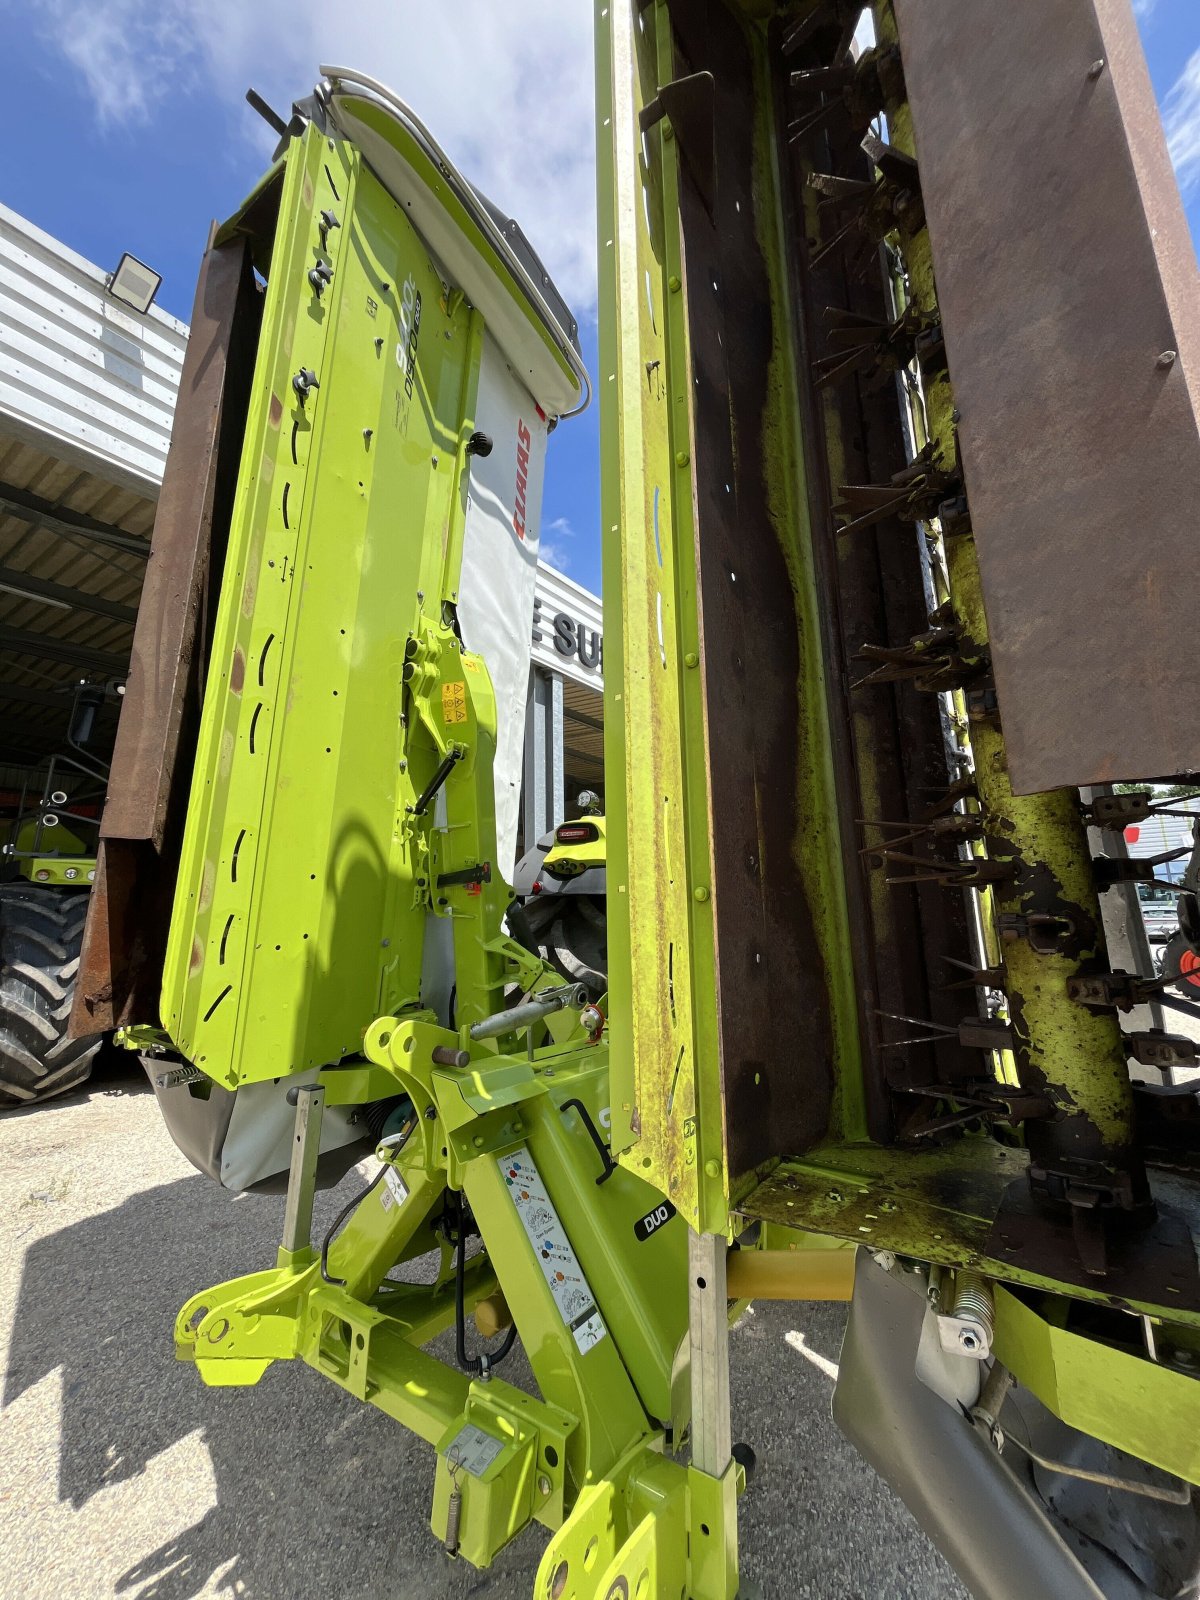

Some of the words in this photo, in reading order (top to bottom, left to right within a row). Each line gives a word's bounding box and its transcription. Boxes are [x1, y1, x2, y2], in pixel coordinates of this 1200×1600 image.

[404, 328, 418, 401] DISCO
[513, 418, 531, 541] CLAAS
[553, 612, 603, 675] SU
[643, 1205, 669, 1234] DUO
